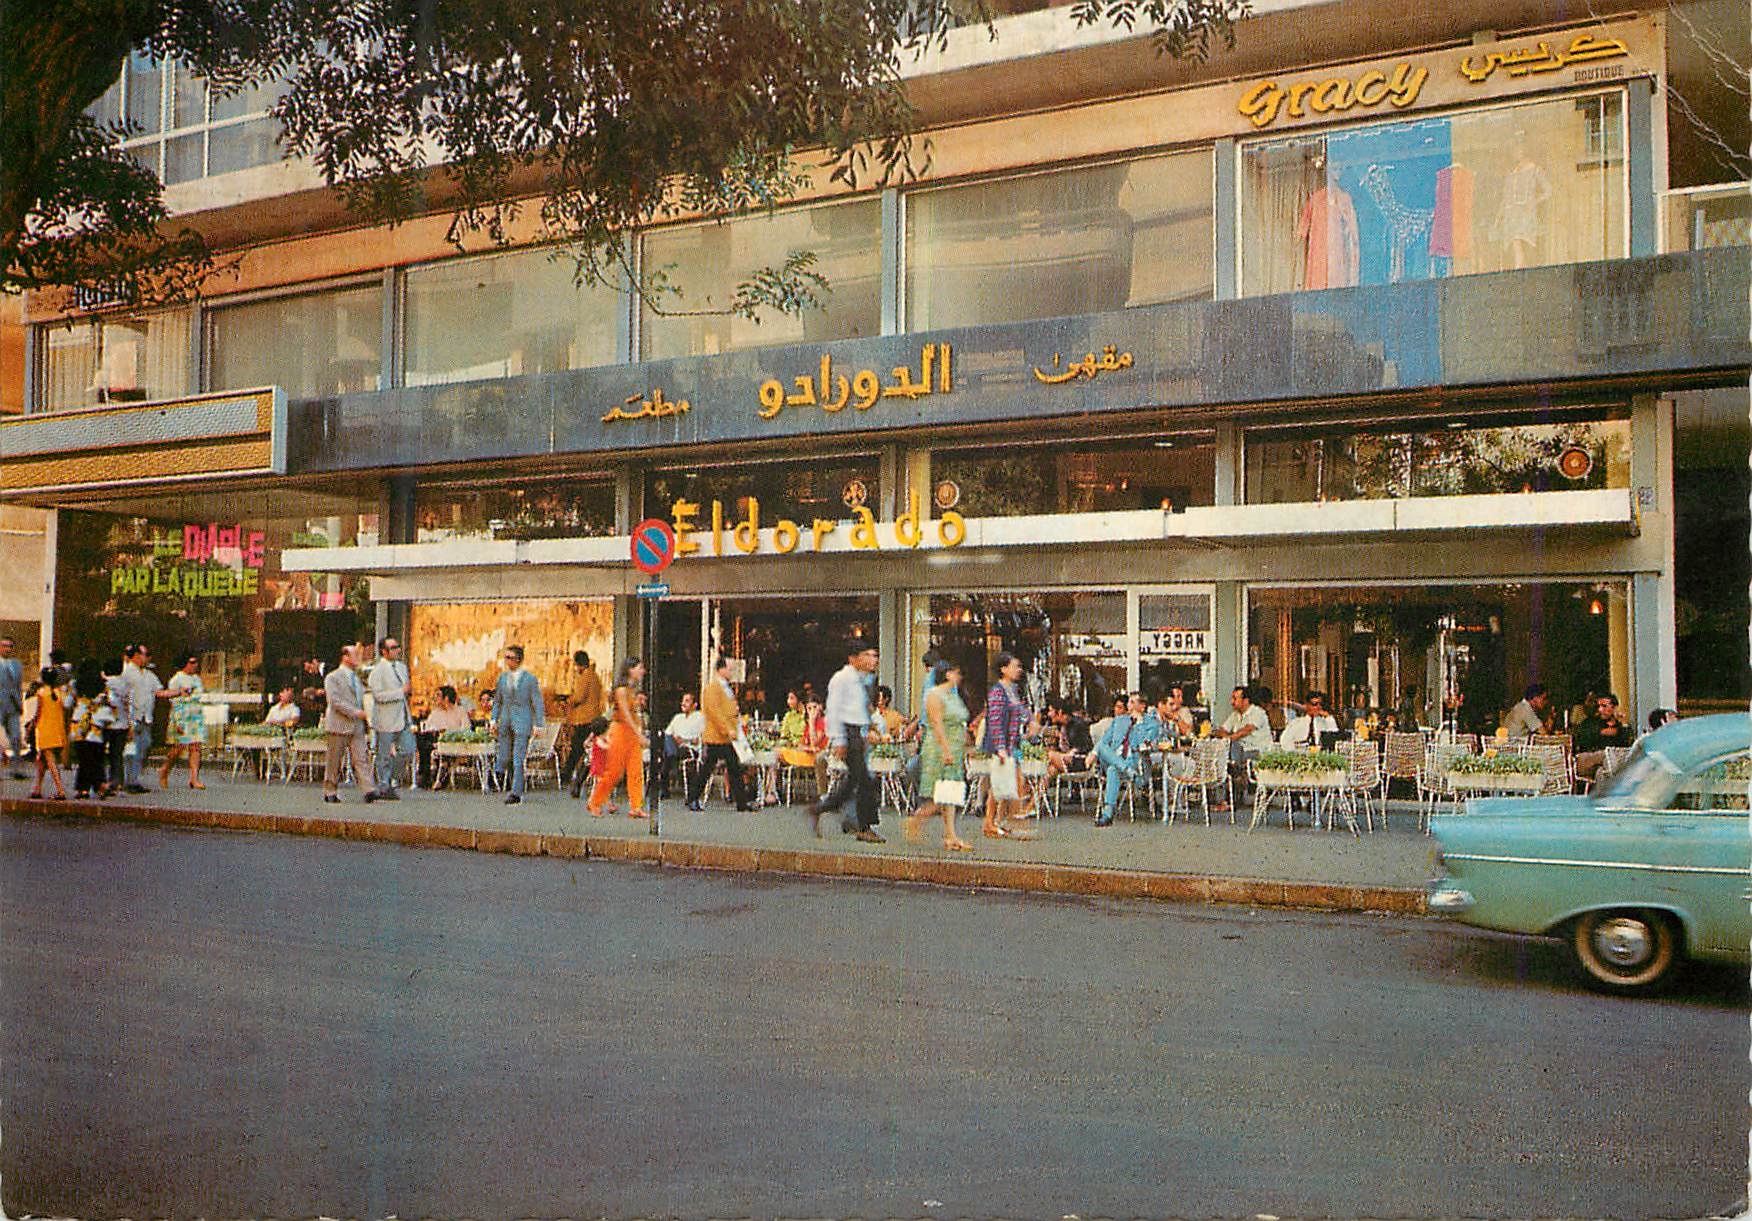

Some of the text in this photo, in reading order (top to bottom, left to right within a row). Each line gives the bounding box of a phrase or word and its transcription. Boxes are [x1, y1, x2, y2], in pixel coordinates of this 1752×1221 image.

[1575, 64, 1625, 82] BOUTIQUE
[758, 342, 953, 418] الدورادو
[600, 388, 690, 422] مطعم
[672, 487, 966, 557] Eldorado
[154, 529, 183, 556] LE
[111, 567, 259, 598] PAR LA QUEUE
